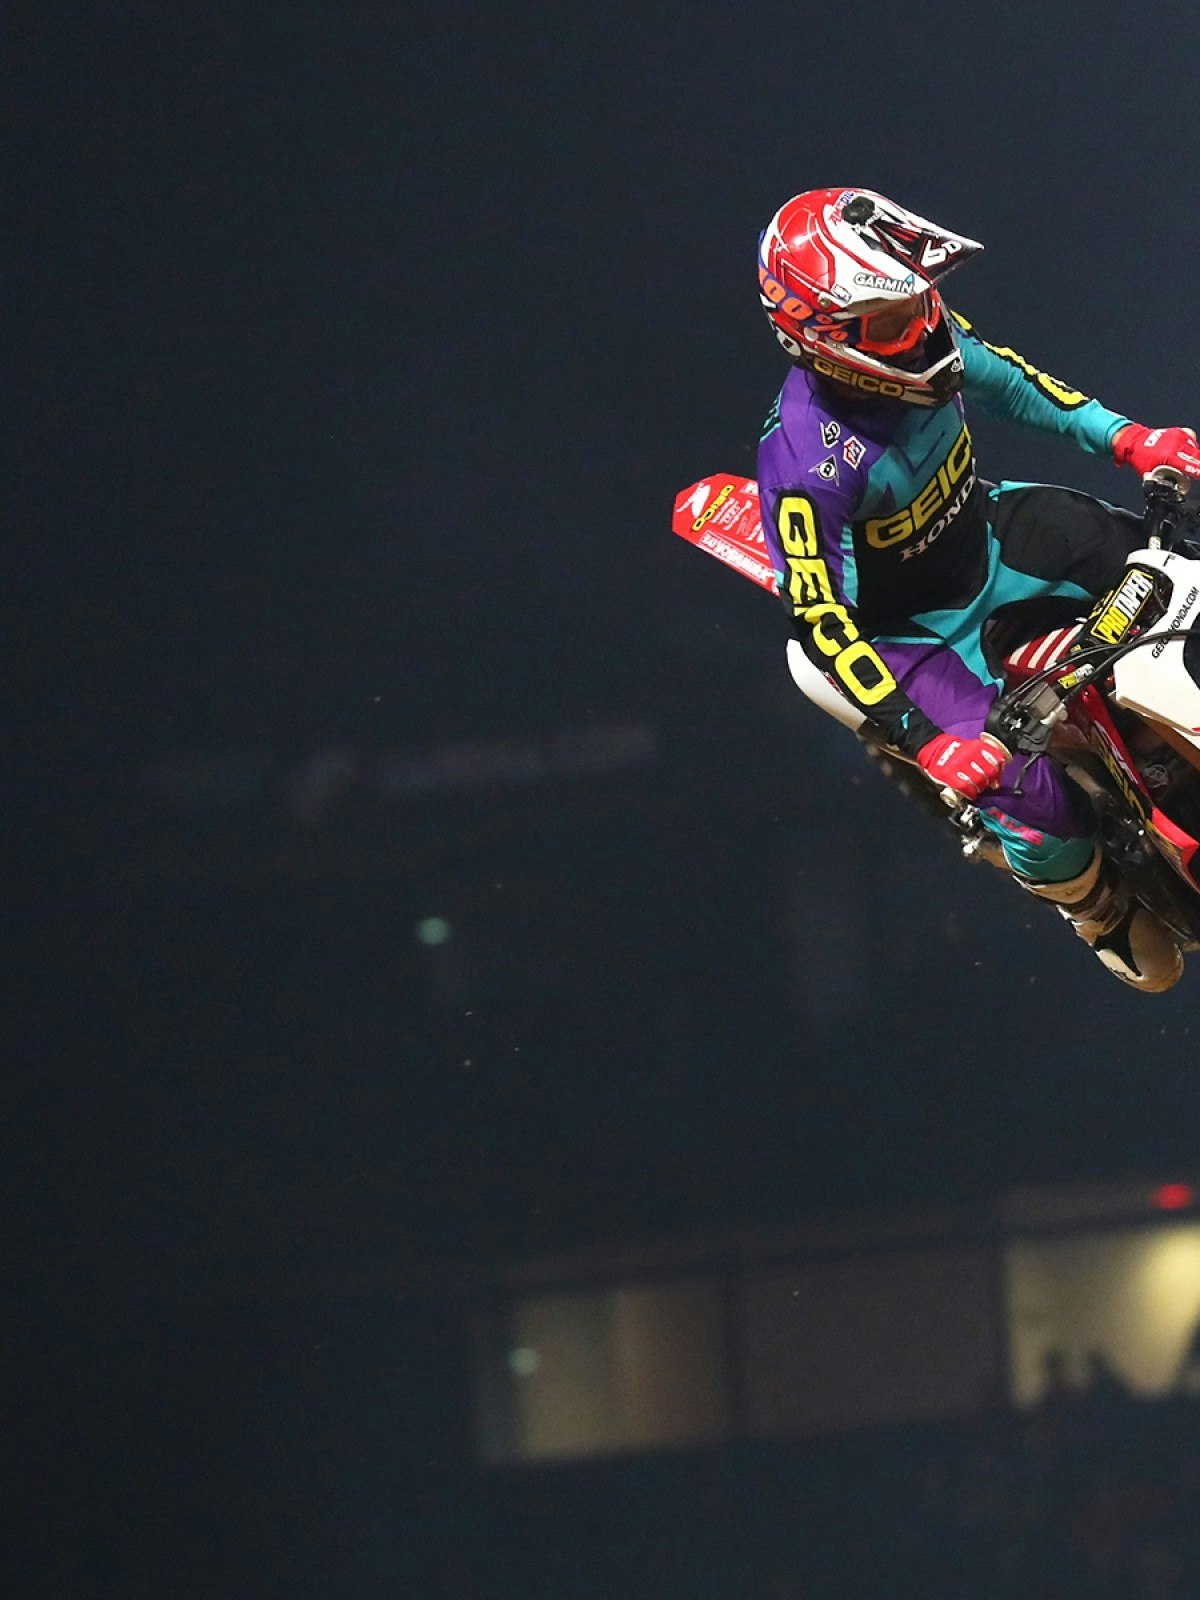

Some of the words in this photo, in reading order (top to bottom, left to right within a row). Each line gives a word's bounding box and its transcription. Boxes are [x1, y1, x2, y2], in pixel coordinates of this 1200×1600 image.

[853, 272, 914, 297] GARMIN
[812, 357, 905, 397] GEICO
[865, 422, 972, 549] GEIC
[900, 472, 977, 561] HOND
[778, 496, 898, 706] GECO
